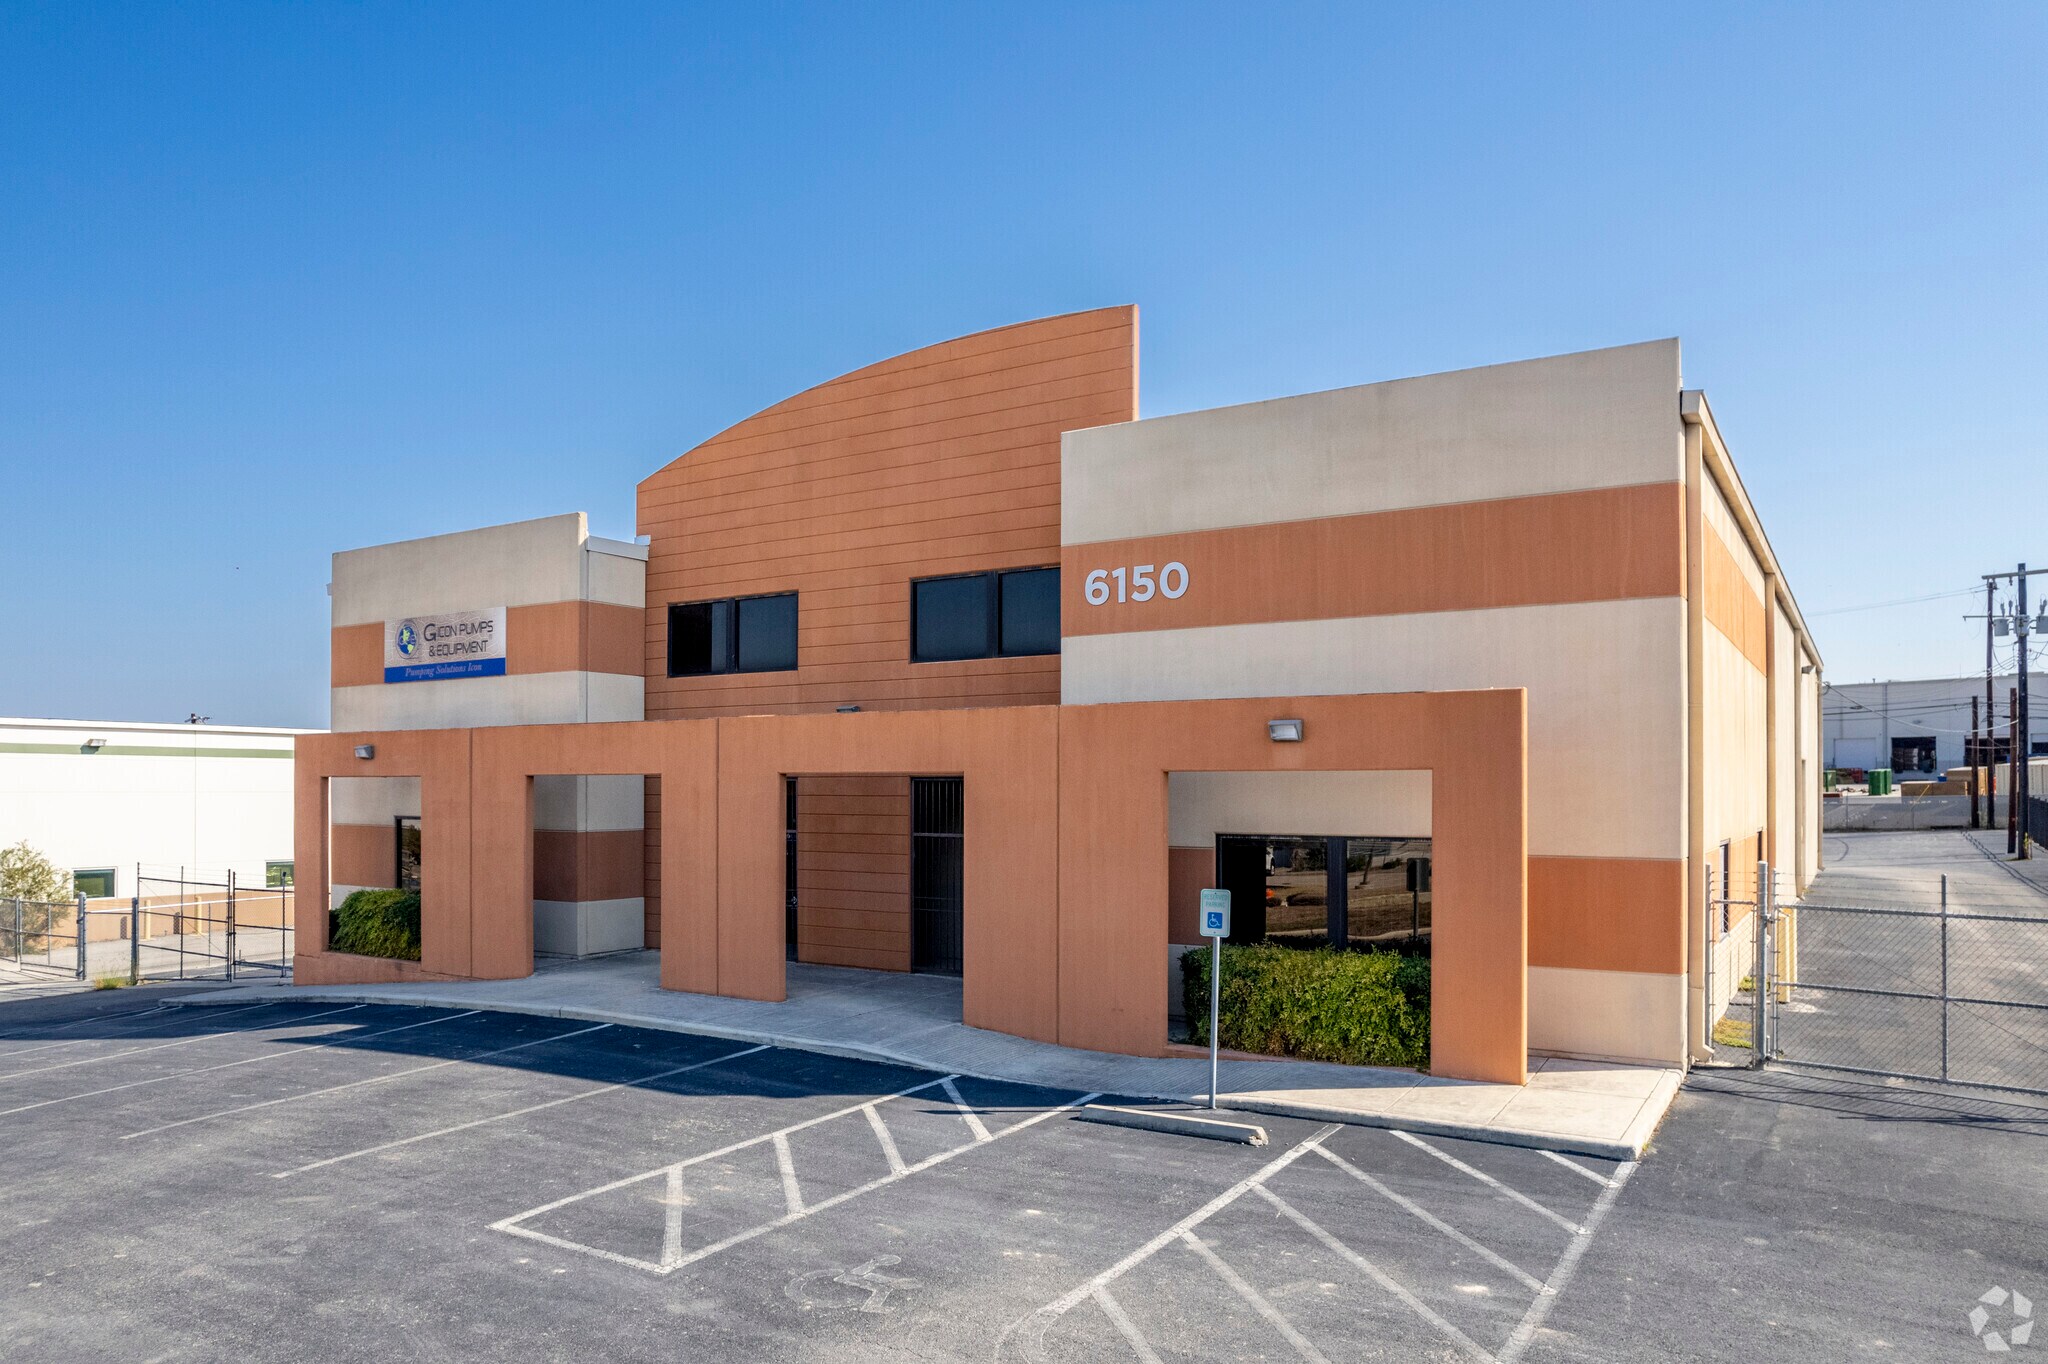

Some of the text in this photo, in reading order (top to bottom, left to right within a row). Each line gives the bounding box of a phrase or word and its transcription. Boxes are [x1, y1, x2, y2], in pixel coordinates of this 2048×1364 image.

[1084, 561, 1189, 606] 6150
[459, 620, 494, 636] PUMPS
[428, 640, 488, 657] & EQUIPMENT
[405, 662, 482, 679] Pumping Solutions Icon
